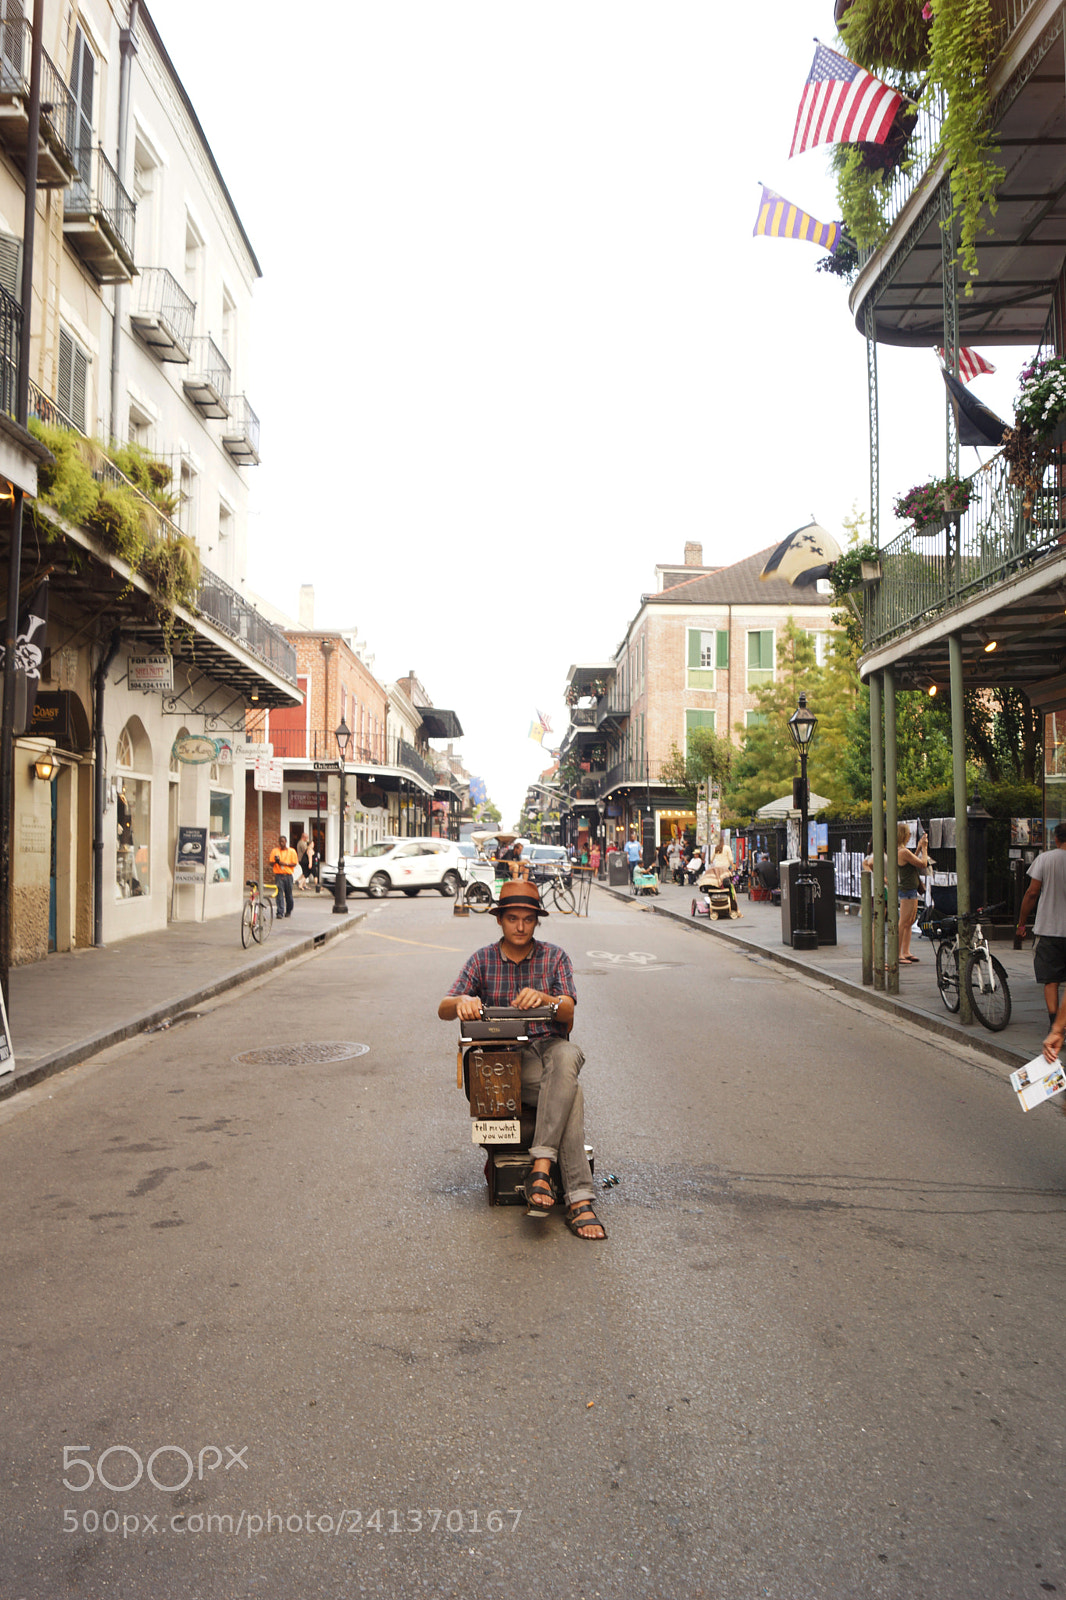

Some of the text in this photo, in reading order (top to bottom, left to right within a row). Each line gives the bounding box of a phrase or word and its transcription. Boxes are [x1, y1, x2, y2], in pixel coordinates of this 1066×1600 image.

[475, 1055, 514, 1078] Poet
[484, 1079, 510, 1096] for
[475, 1093, 516, 1114] hire
[475, 1123, 487, 1131] tell
[499, 1122, 516, 1131] what
[482, 1133, 496, 1142] you
